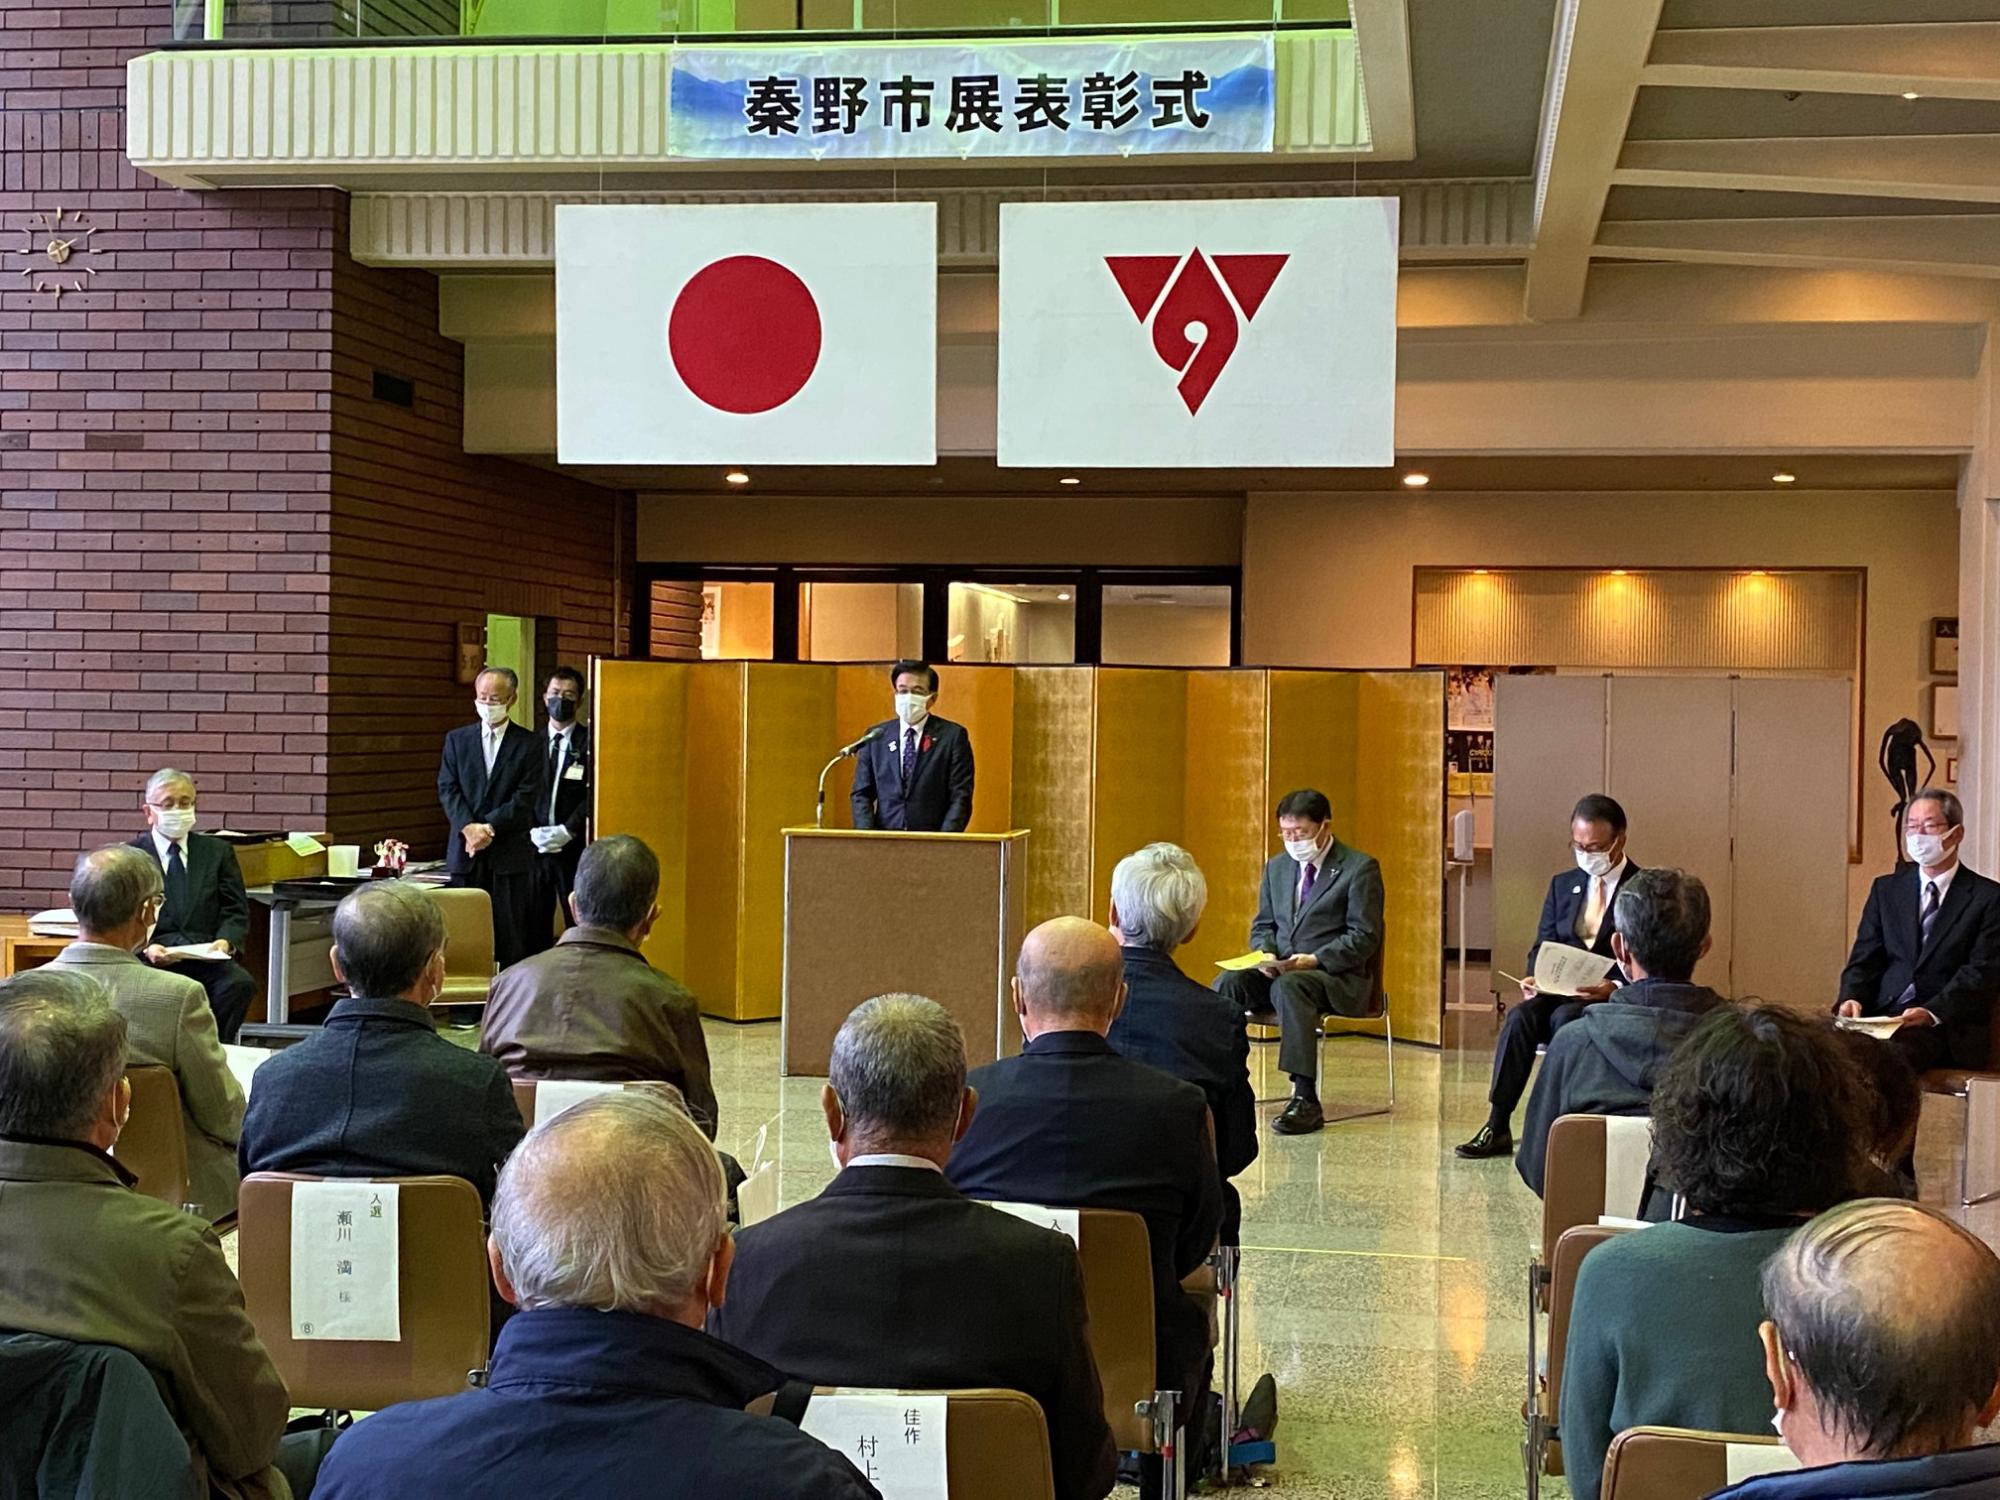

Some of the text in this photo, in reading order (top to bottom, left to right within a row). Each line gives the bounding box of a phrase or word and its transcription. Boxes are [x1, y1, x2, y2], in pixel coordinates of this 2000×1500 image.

[744, 69, 1211, 135] 秦野市展表彰式
[370, 1193, 383, 1218] 入選
[904, 1408, 921, 1445] 佳作
[857, 1434, 880, 1481] 村上
